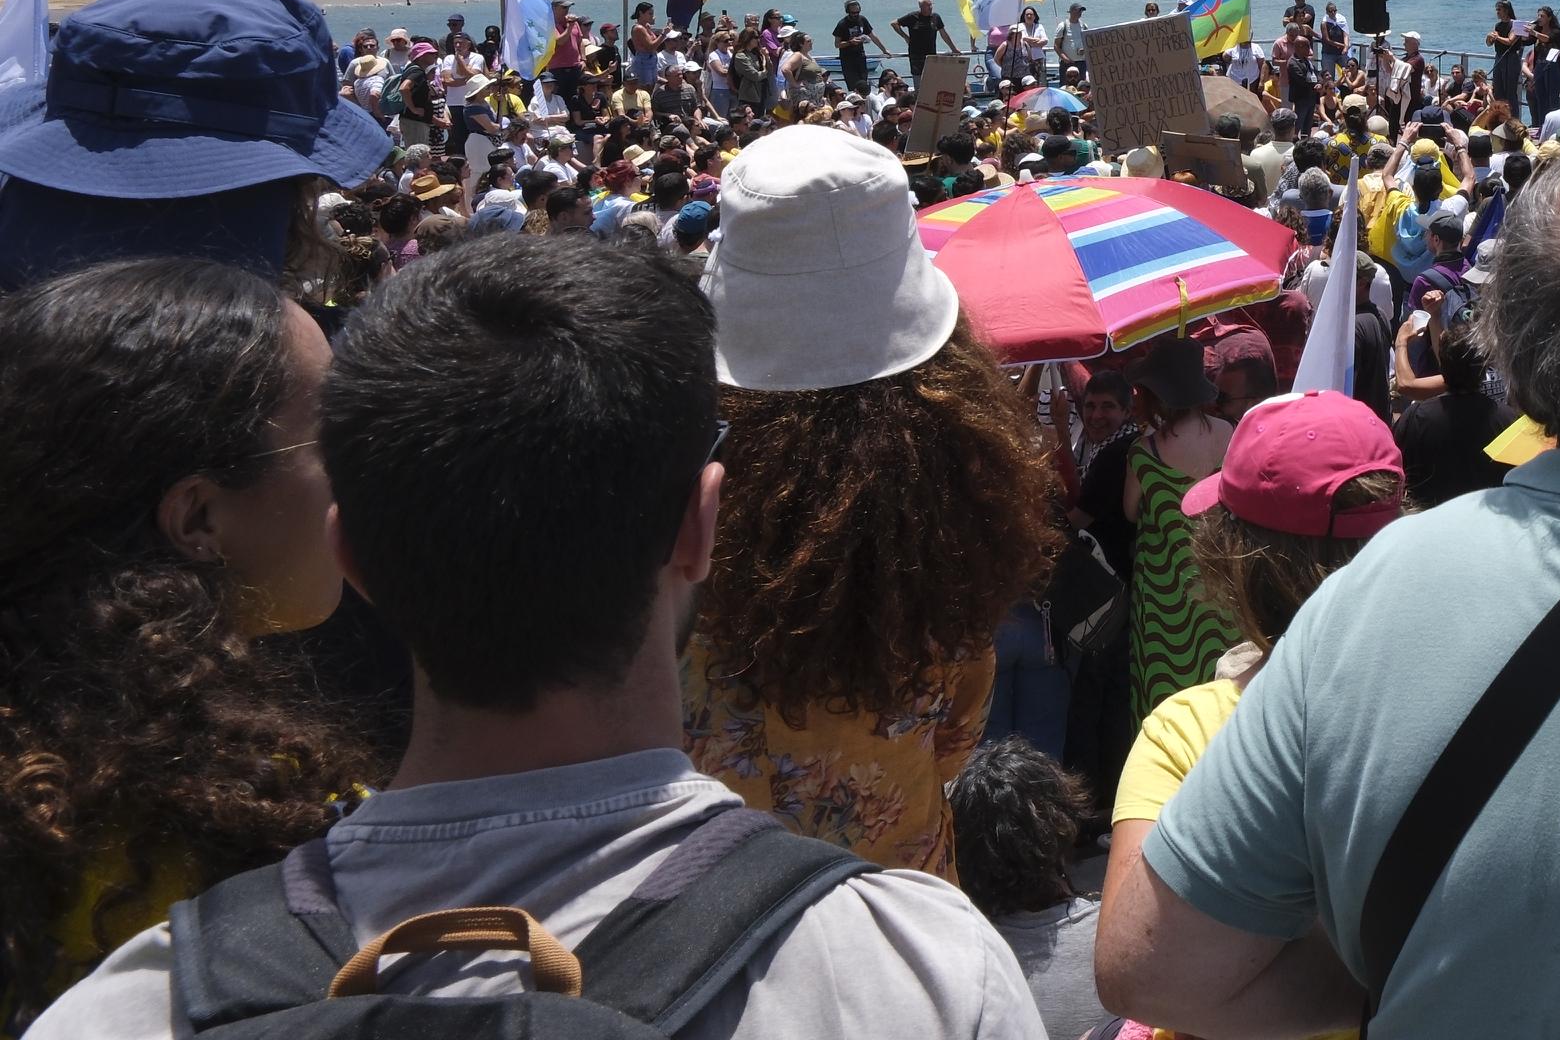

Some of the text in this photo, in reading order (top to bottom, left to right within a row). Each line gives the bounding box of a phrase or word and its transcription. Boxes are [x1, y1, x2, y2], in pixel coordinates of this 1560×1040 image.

[1141, 40, 1150, 55] Y
[1116, 103, 1144, 128] QUE
[1103, 127, 1125, 151] SE
